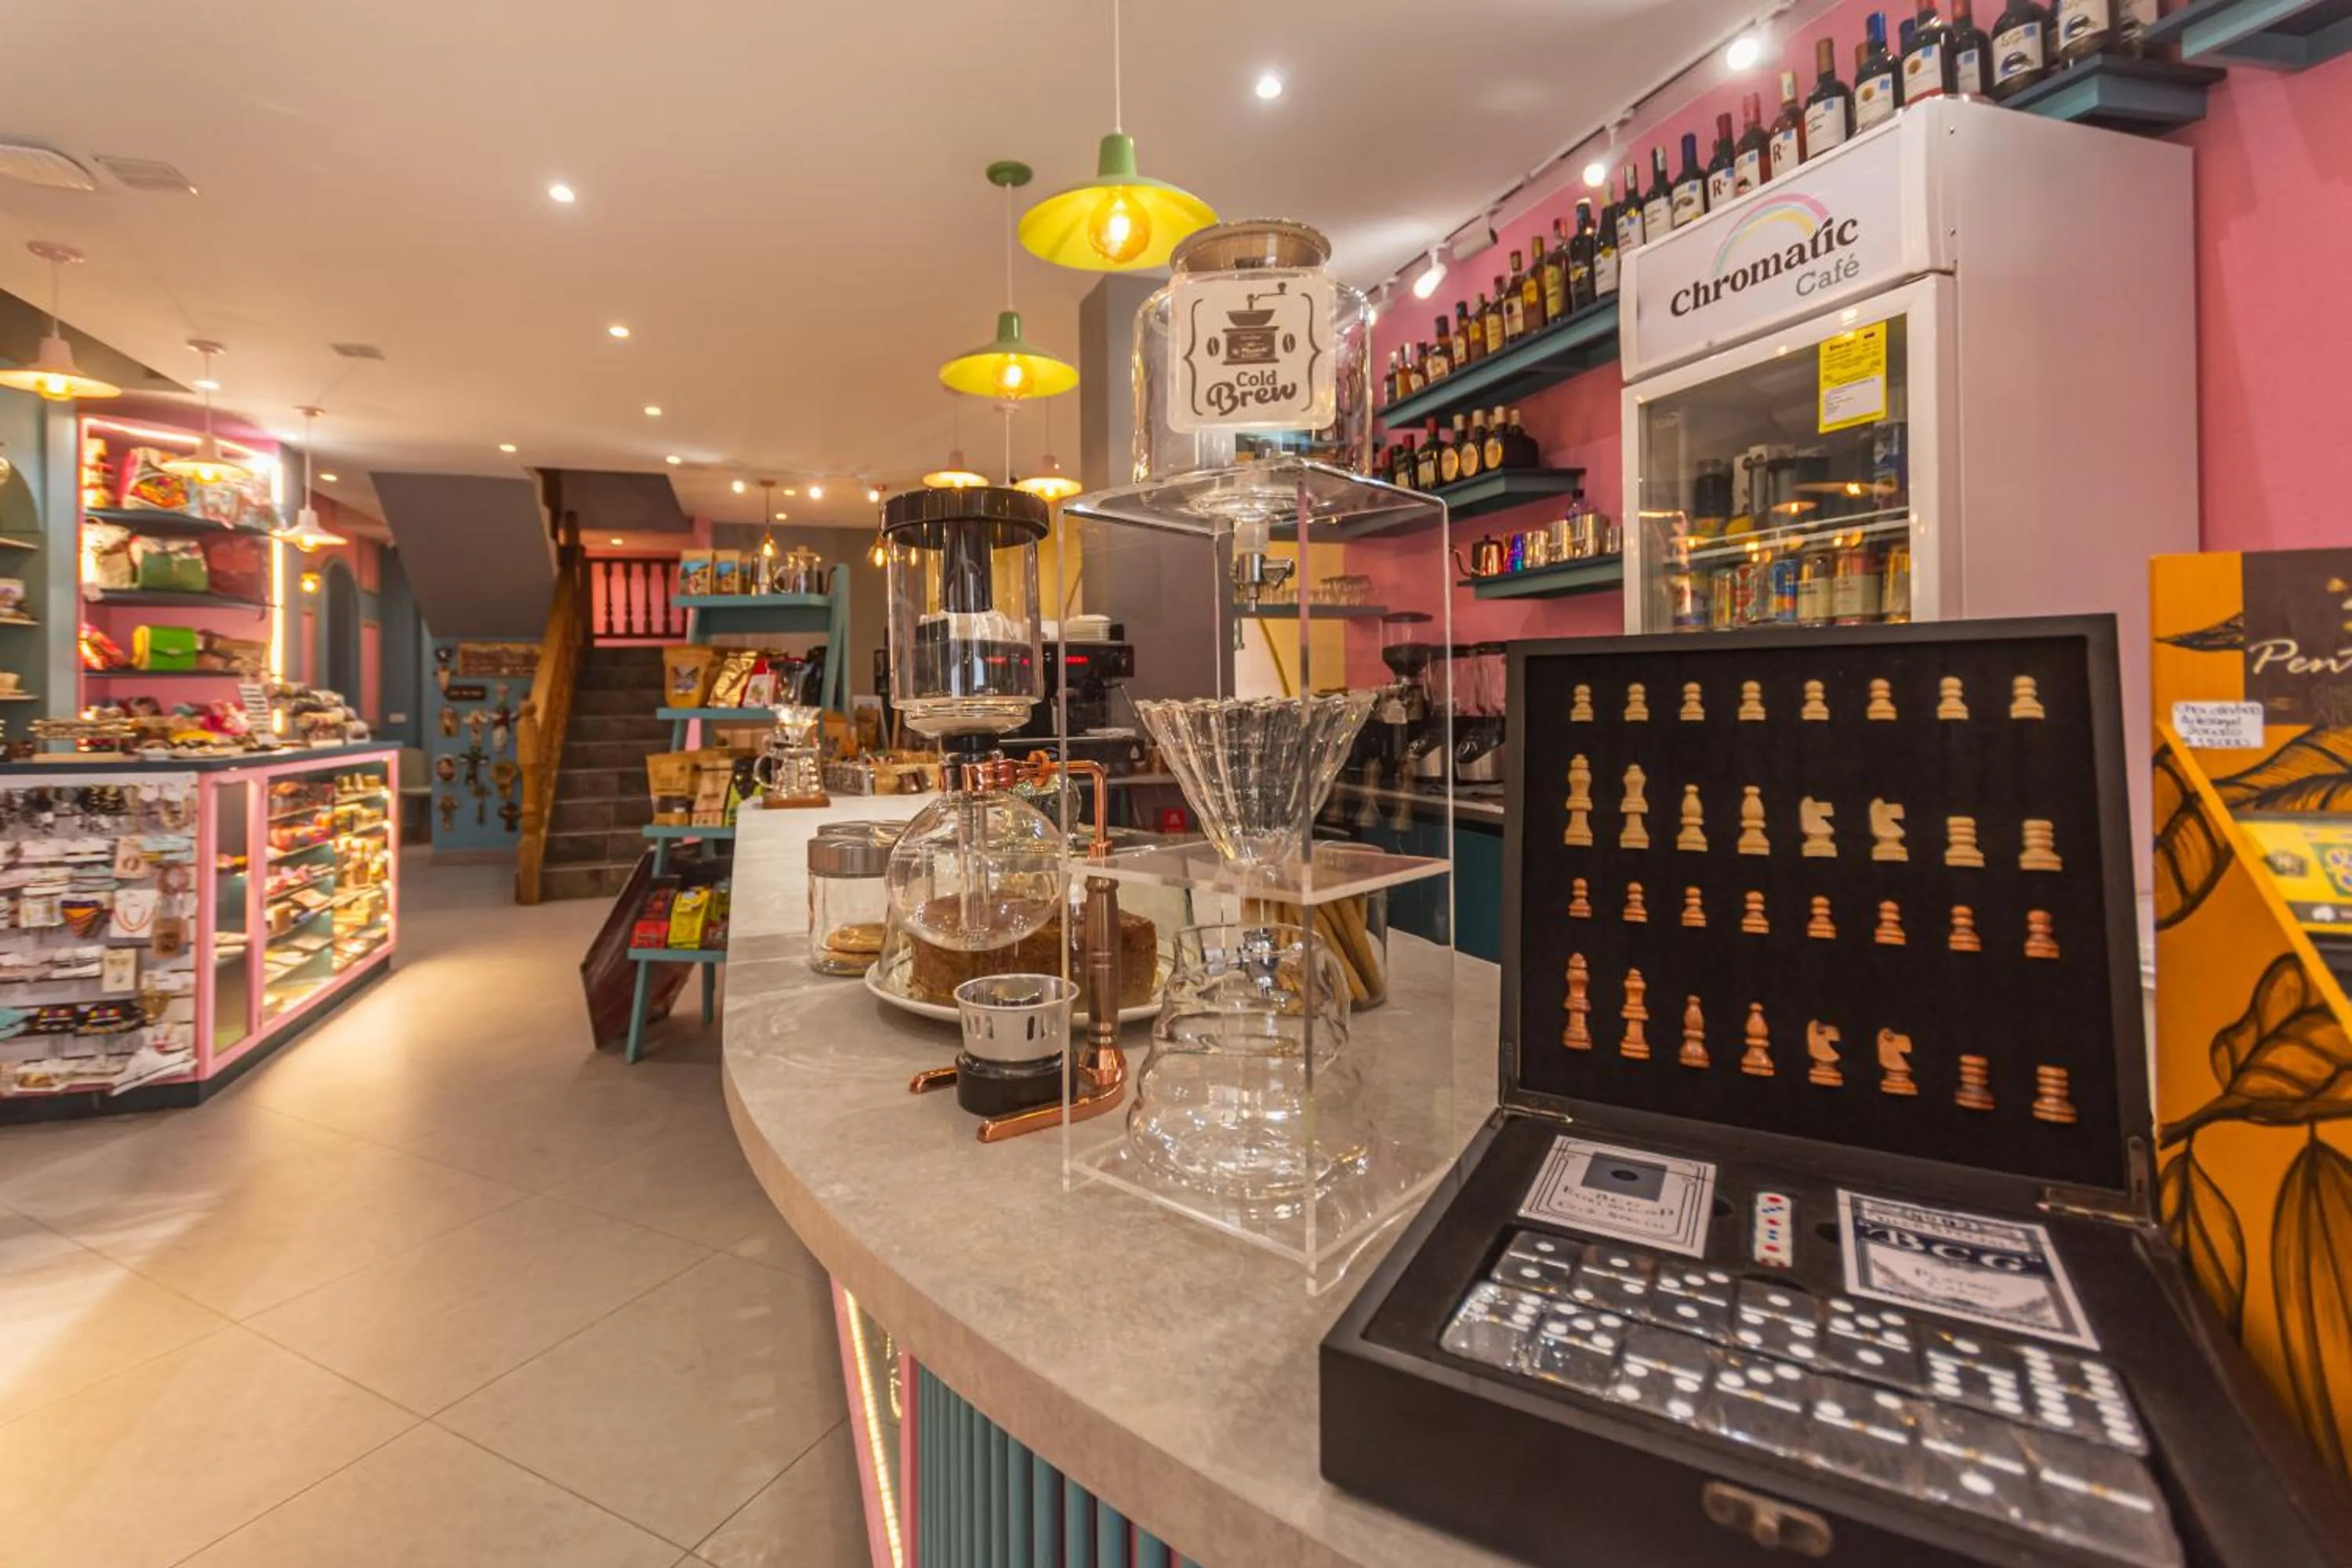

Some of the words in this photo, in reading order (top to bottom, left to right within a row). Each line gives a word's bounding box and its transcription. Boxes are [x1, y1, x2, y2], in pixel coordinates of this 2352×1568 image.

[1670, 216, 1860, 318] Chromatic
[1795, 252, 1860, 298] Café
[1236, 369, 1277, 387] Cold
[1206, 381, 1297, 417] Brew
